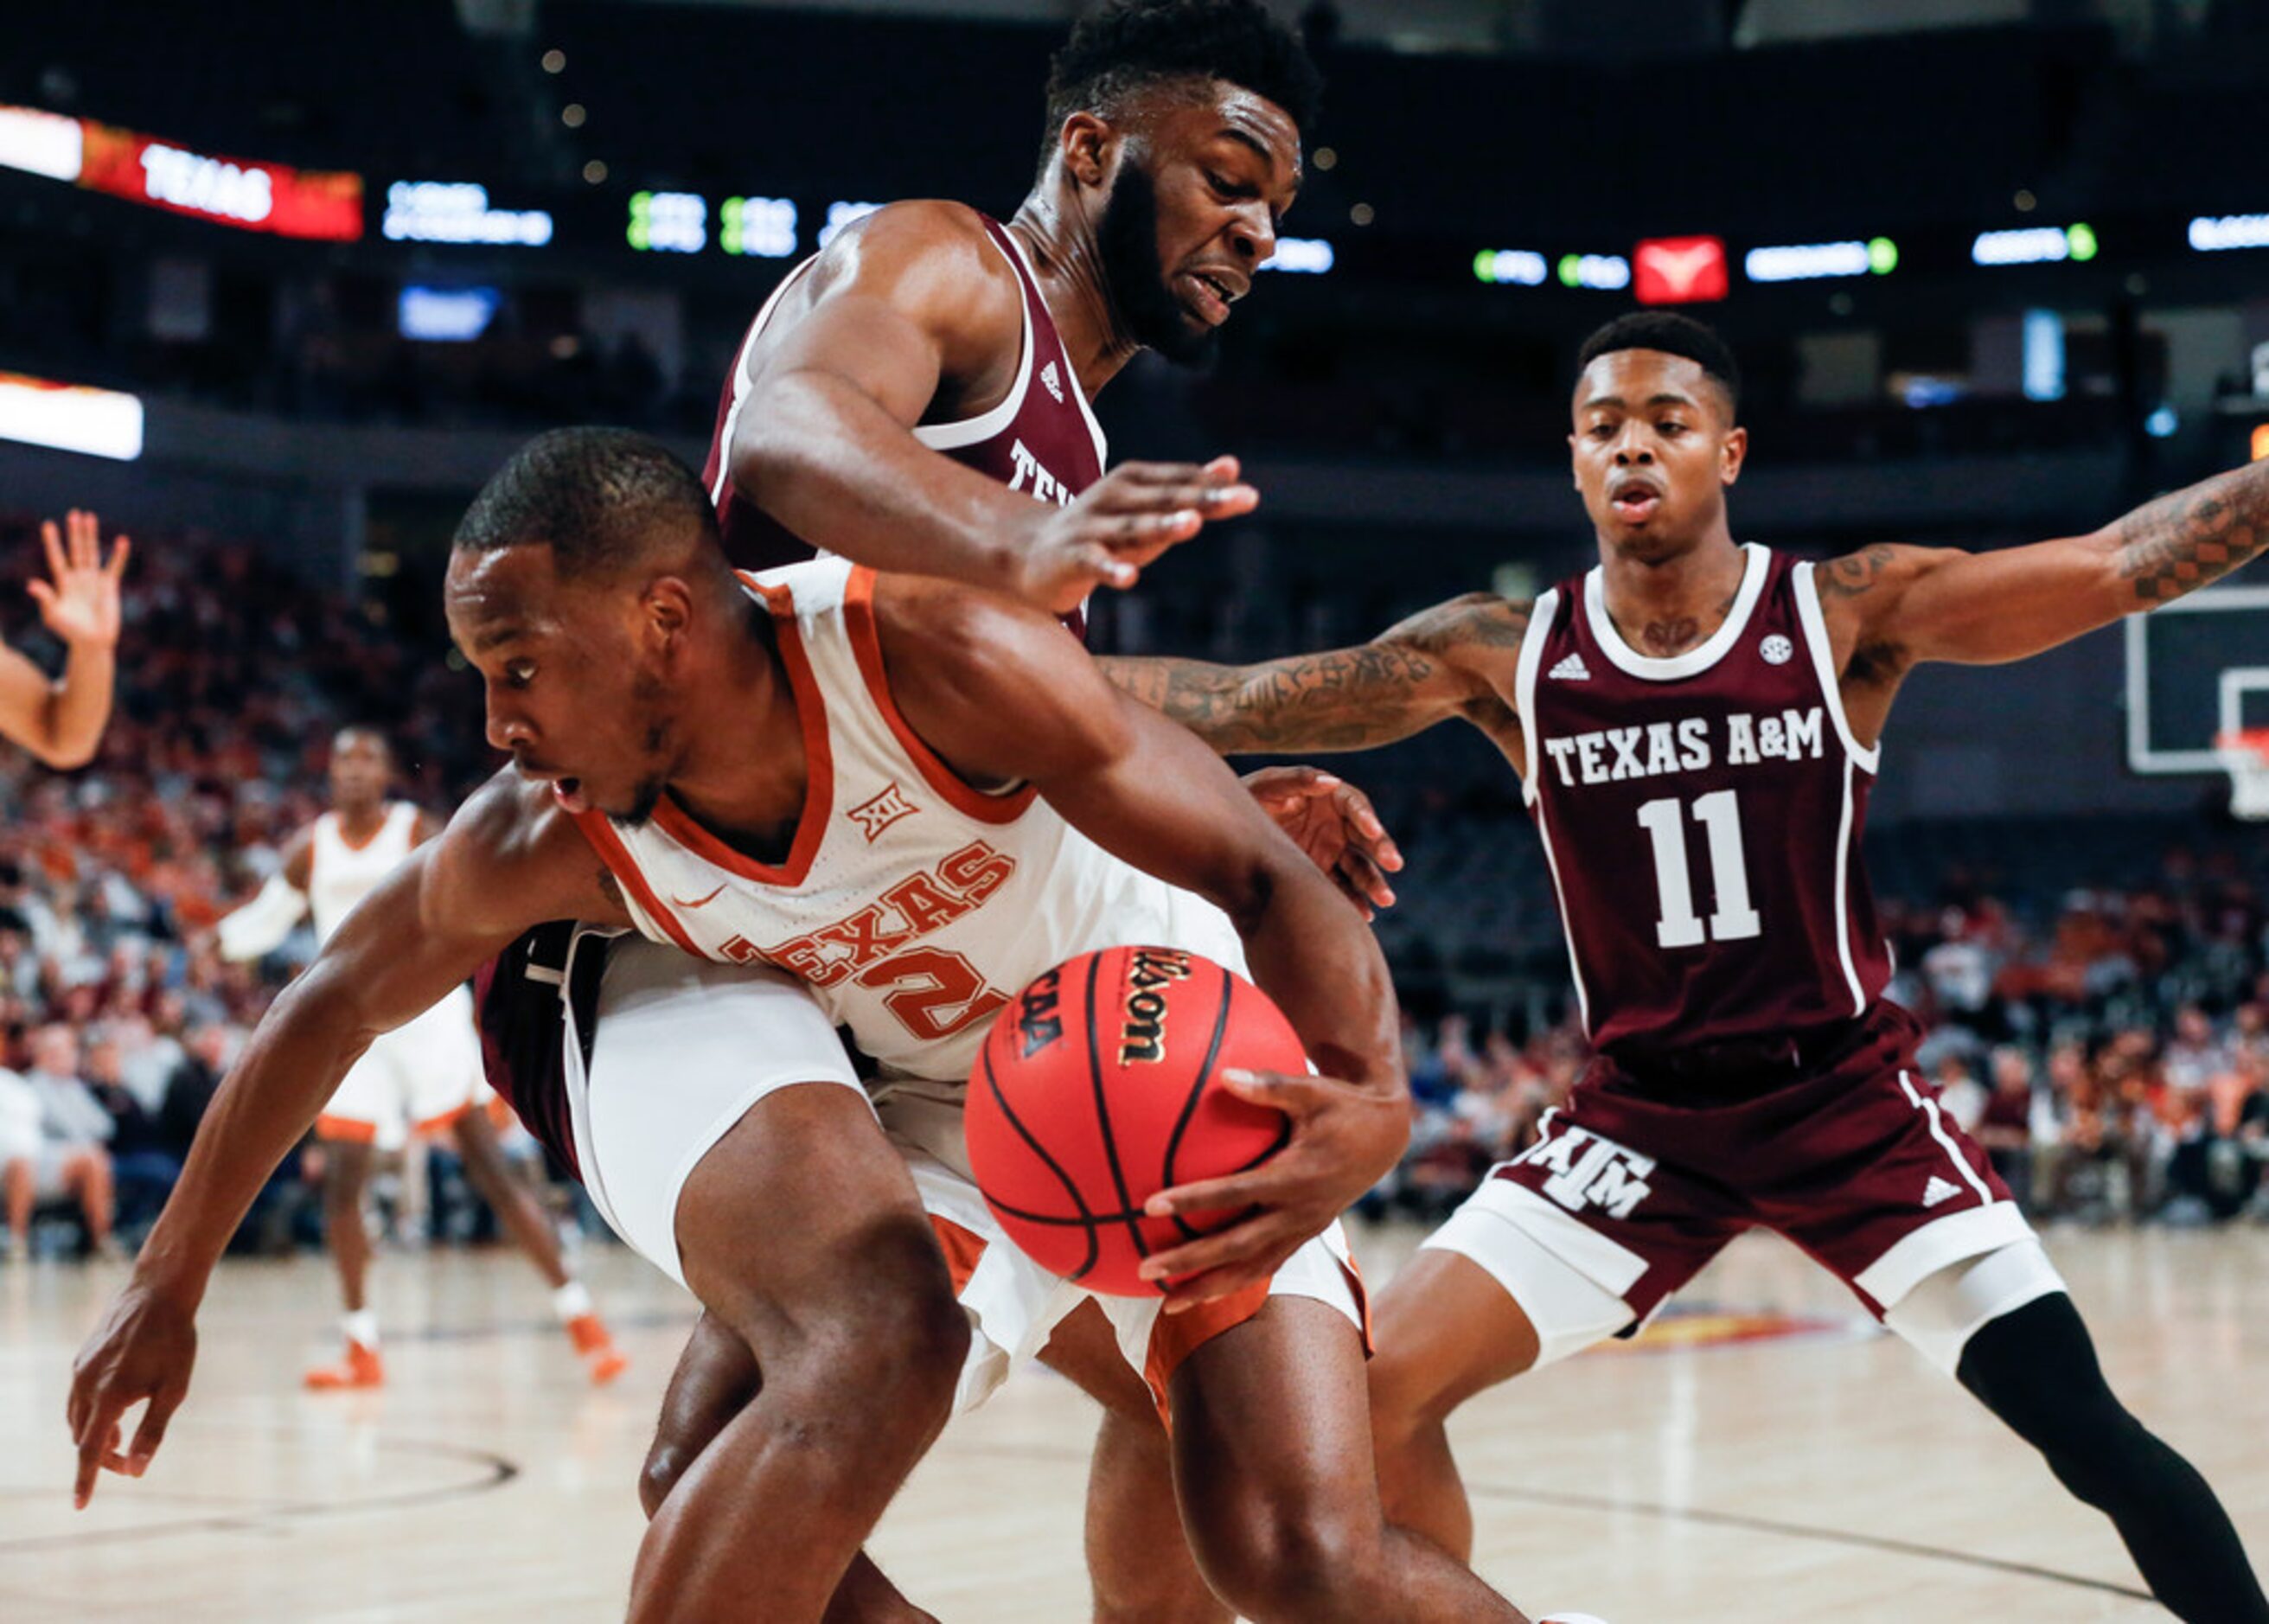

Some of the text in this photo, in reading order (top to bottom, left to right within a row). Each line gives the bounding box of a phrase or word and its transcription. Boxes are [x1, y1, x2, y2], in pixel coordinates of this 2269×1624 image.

[1544, 707, 1824, 787] TEXAS A&M
[717, 839, 1017, 988] TEXAS
[1637, 789, 1761, 949] 11
[853, 945, 1015, 1039] 2
[1019, 962, 1064, 1060] CAA
[1118, 945, 1192, 1066] ilson
